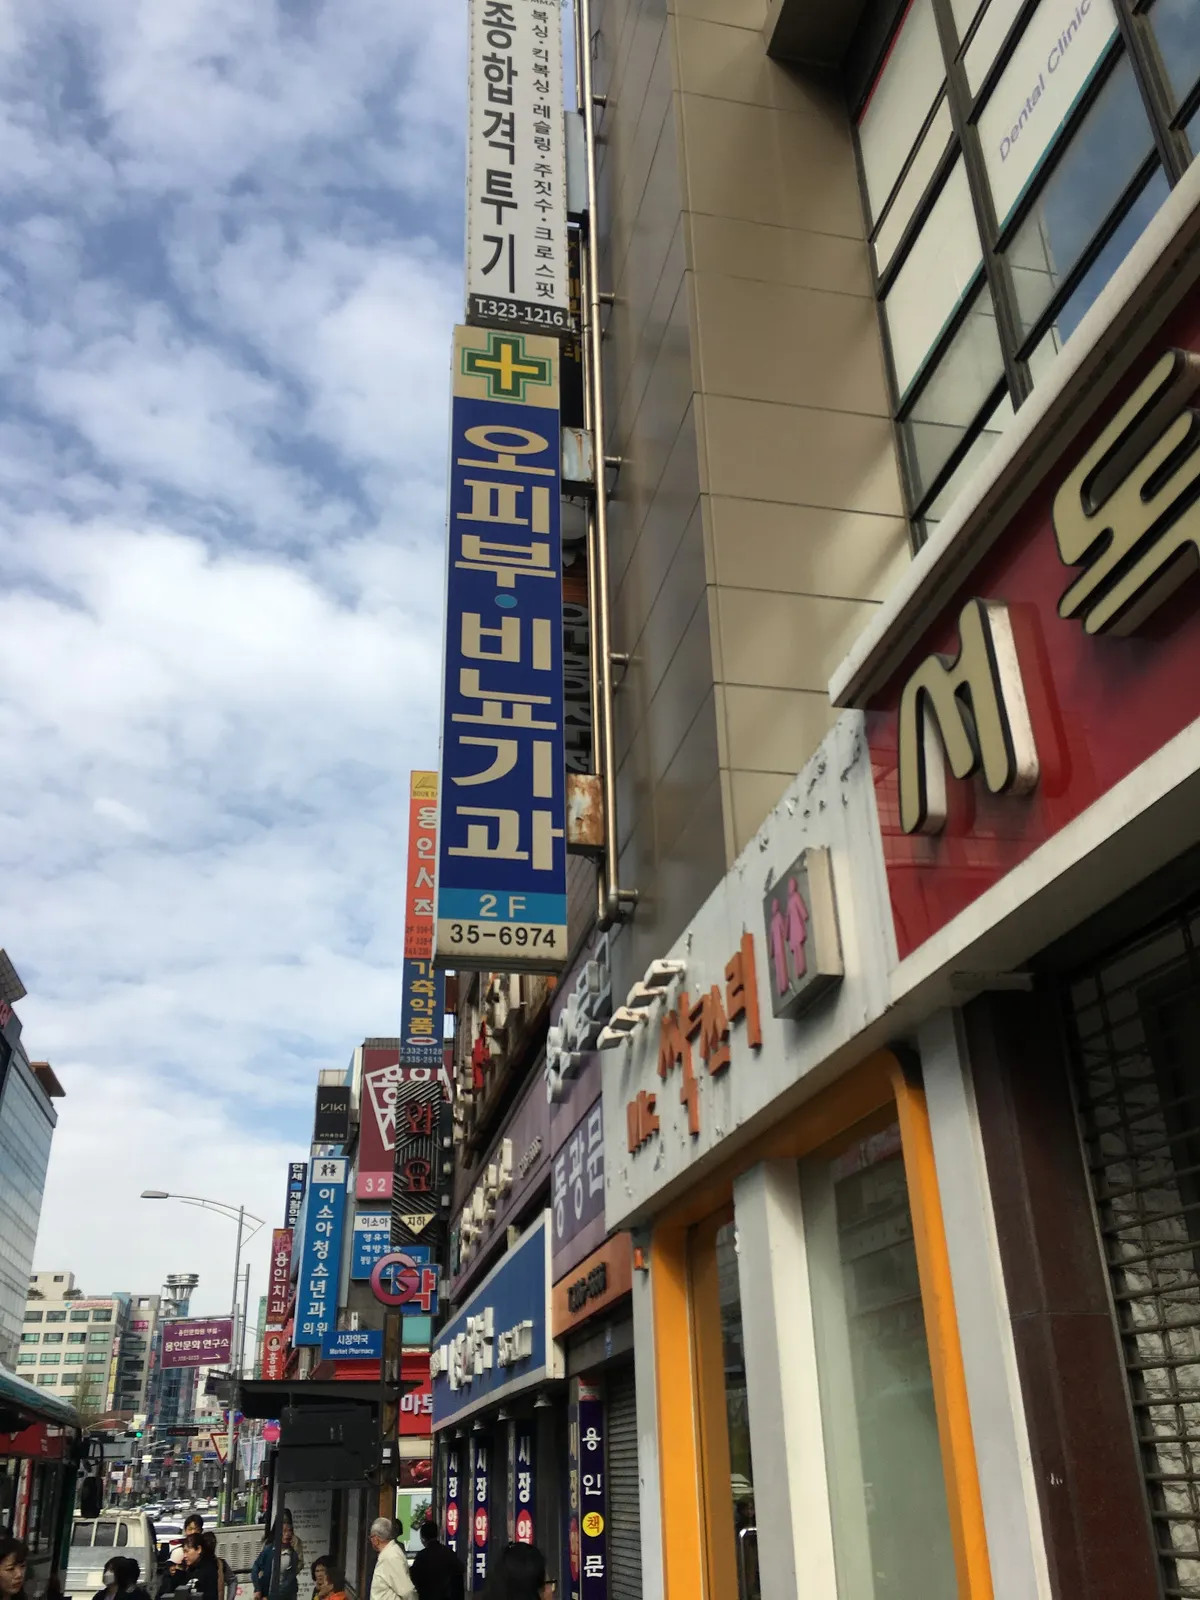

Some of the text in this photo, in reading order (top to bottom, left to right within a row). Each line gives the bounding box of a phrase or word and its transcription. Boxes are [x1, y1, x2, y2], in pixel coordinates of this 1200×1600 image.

[1000, 73, 1046, 163] Dental
[480, 0, 519, 294] 종합격투기
[474, 298, 564, 326] T.323-1216
[450, 923, 557, 949] 35-6974
[320, 1103, 347, 1112] VIKI
[361, 1217, 391, 1227] 이소아
[407, 1216, 426, 1227] 지하
[306, 1187, 336, 1319] 이소아청소년과
[271, 1251, 289, 1315] 용인치과
[202, 1338, 230, 1349] 연구소
[336, 1334, 369, 1346] 시장약국
[475, 1448, 488, 1579] 시장약국
